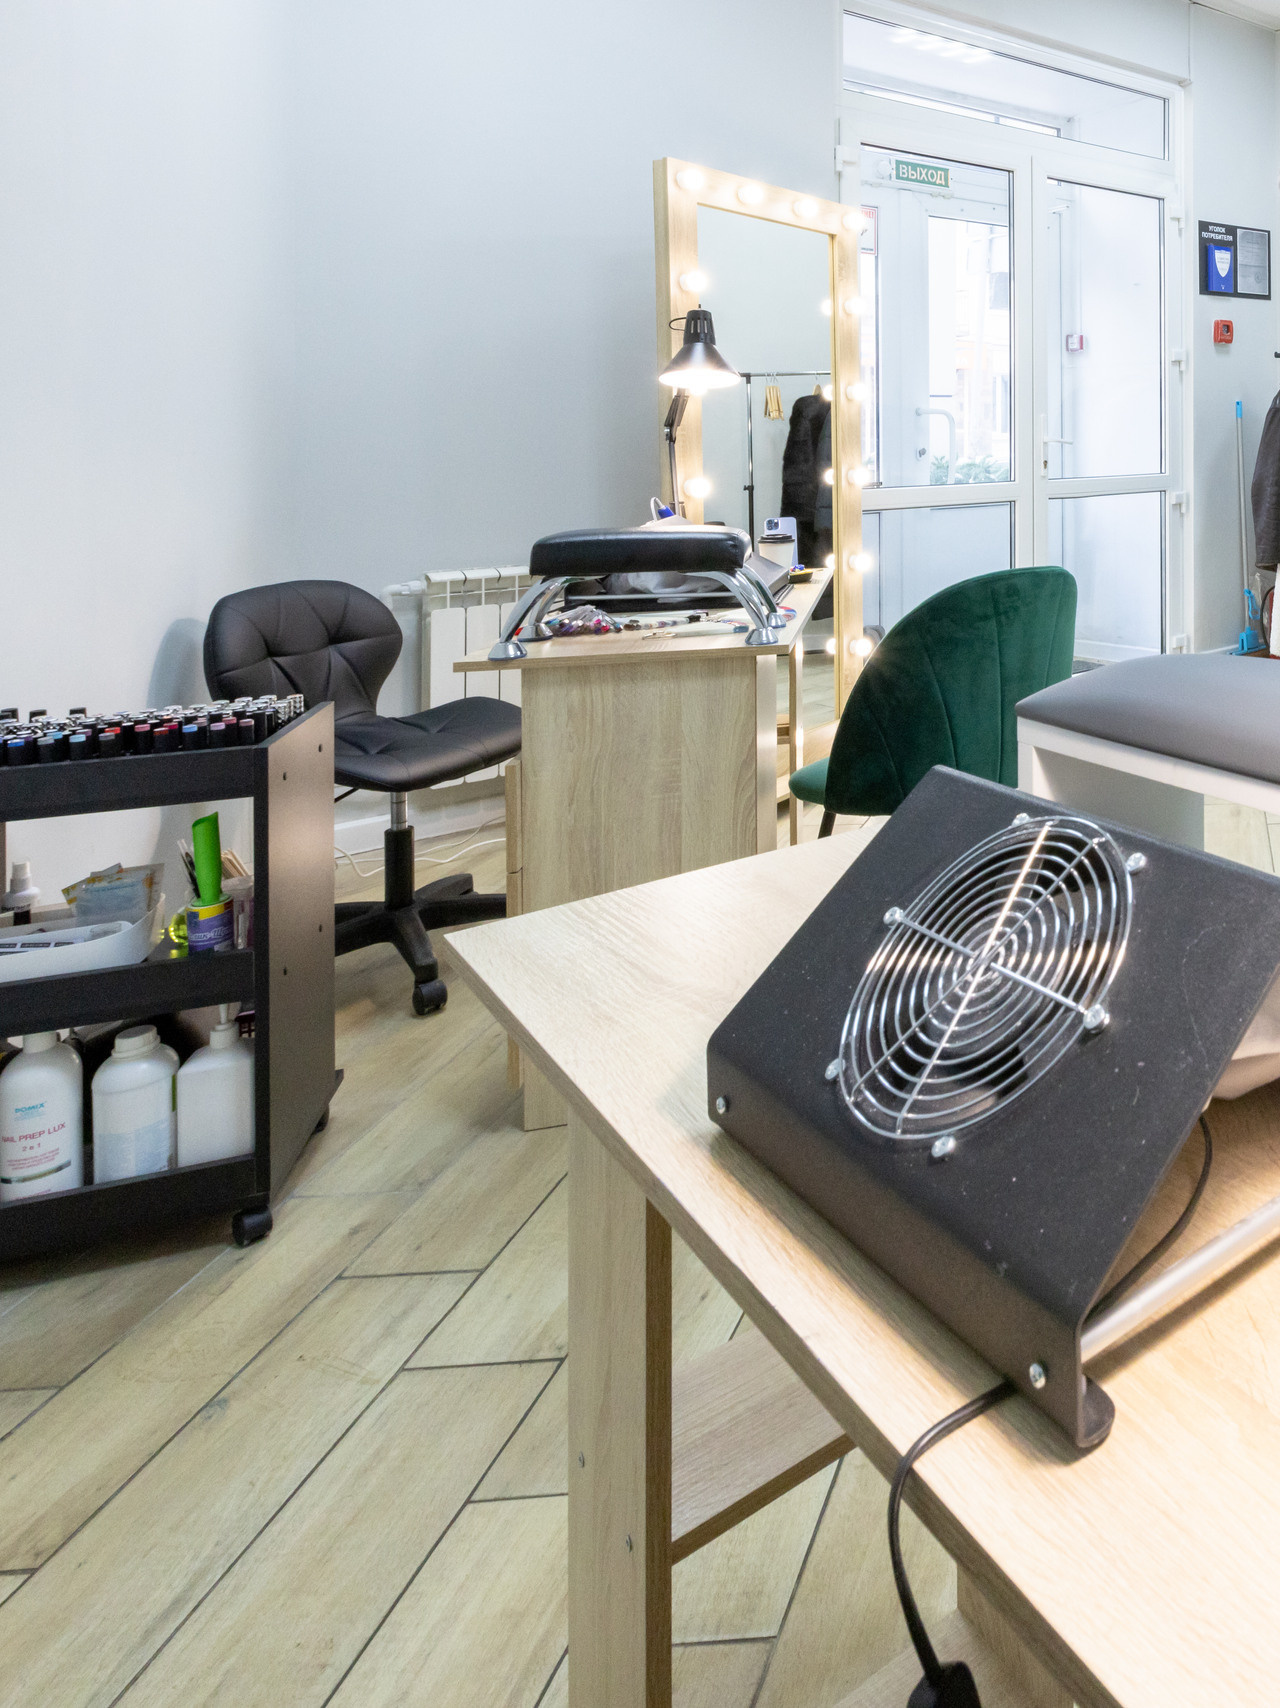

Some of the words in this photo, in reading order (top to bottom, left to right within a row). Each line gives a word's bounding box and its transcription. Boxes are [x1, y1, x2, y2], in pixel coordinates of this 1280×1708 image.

[899, 164, 945, 186] ВЫХОД
[1208, 225, 1226, 233] УГОЛОК
[1201, 232, 1233, 242] ПОТРЕБИТЕЛЯ
[18, 1129, 46, 1142] PREP
[47, 1122, 66, 1135] LUX
